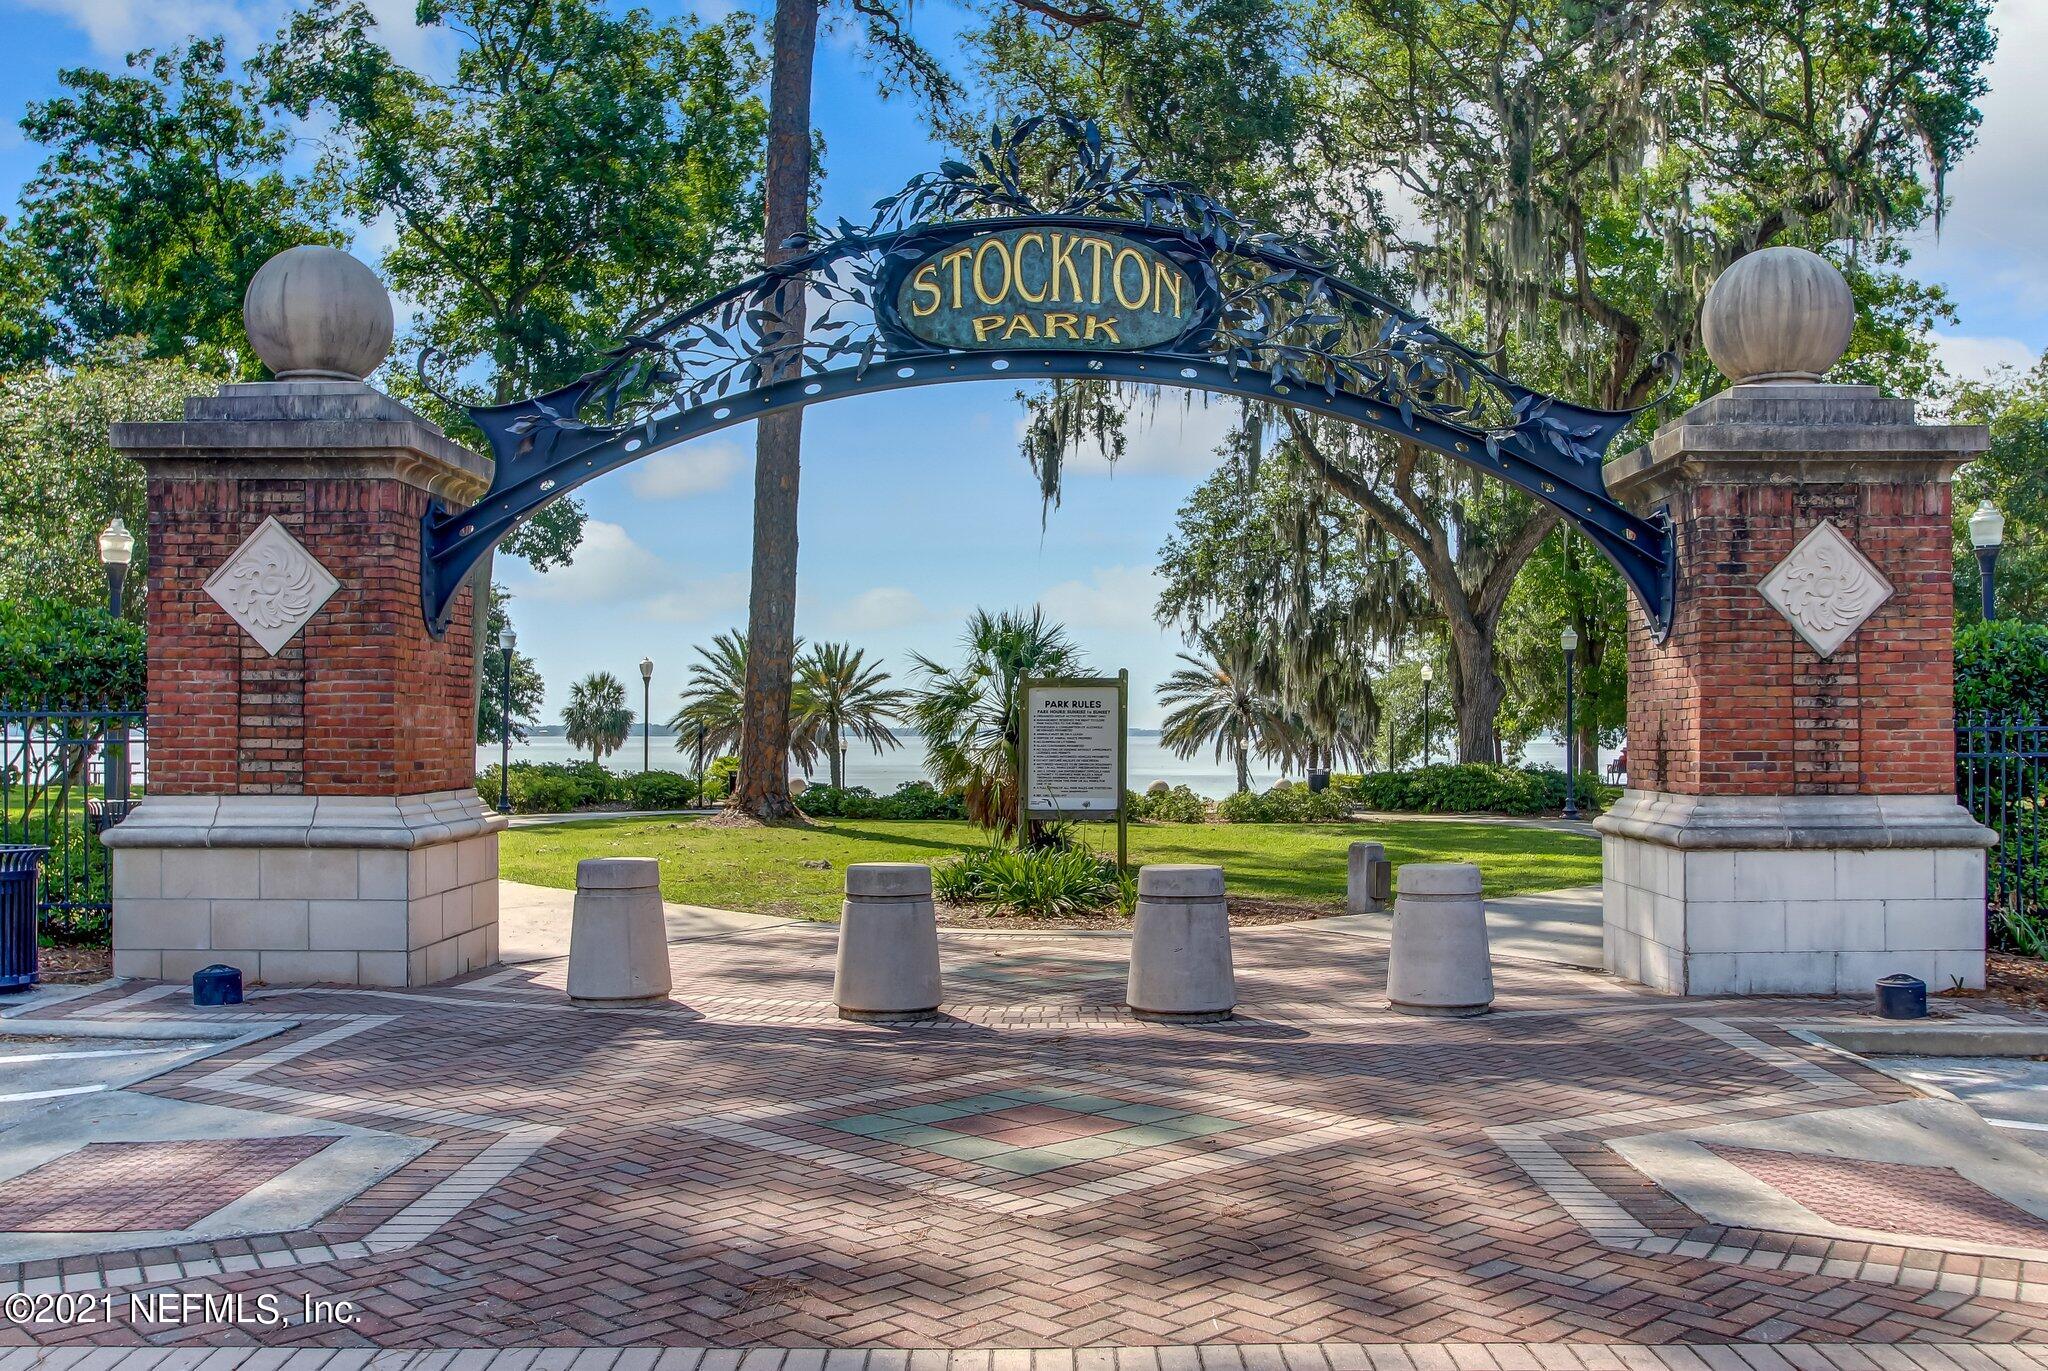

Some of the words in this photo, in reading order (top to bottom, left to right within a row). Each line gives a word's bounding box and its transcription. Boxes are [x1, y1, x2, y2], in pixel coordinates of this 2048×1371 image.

[912, 233, 1182, 319] STOCKTON
[972, 312, 1121, 344] PARK
[1045, 700, 1069, 708] PARK
[1072, 700, 1102, 708] RULES
